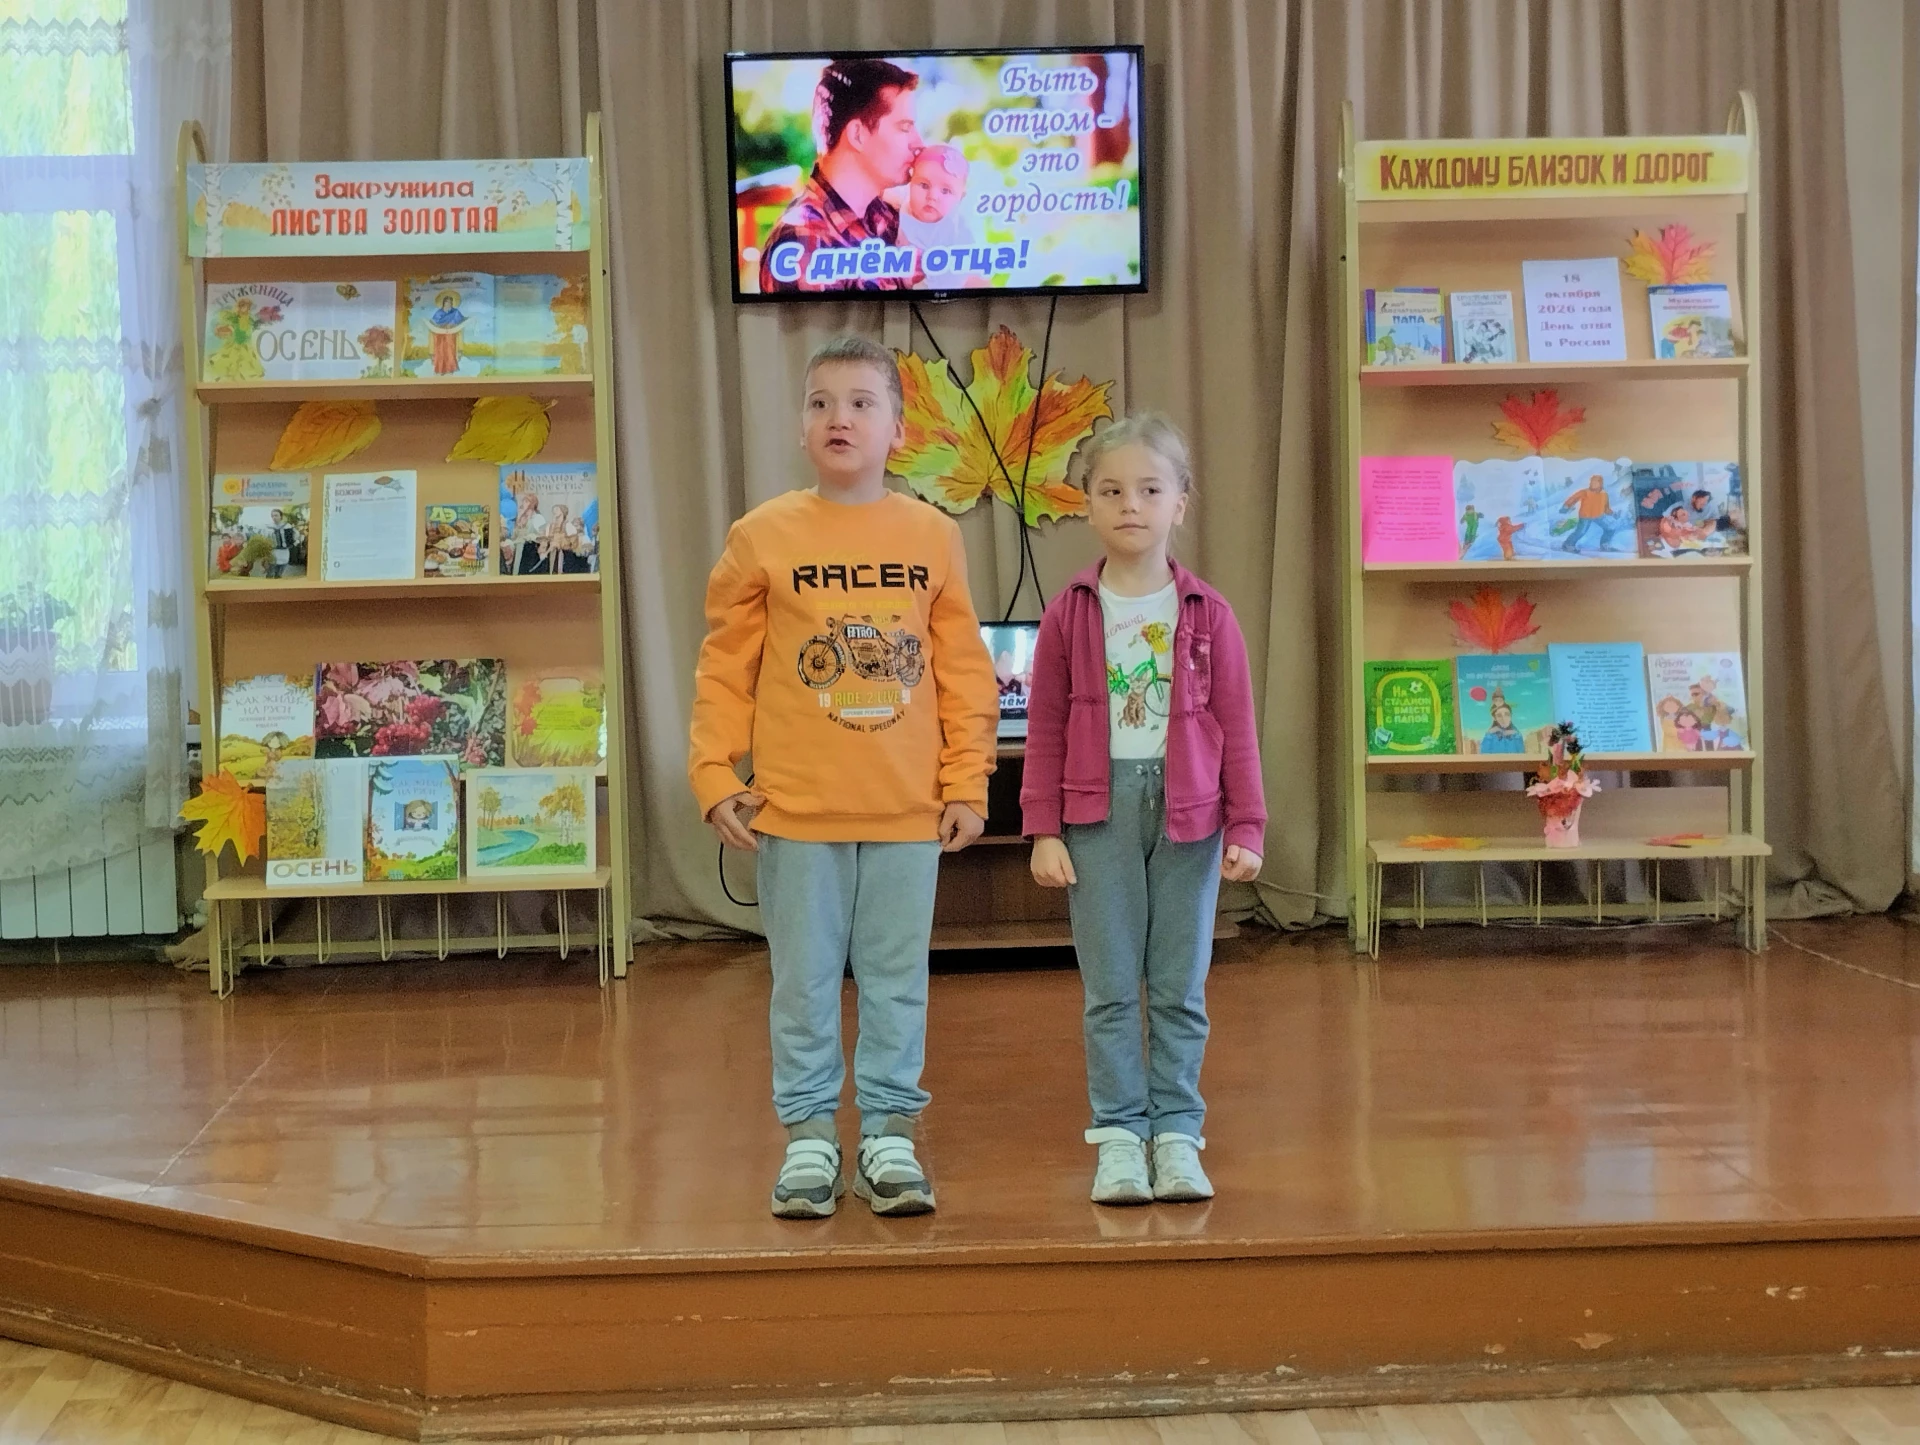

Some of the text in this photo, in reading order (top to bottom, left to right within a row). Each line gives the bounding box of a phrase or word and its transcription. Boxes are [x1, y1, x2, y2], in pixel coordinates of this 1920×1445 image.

[1003, 66, 1095, 94] Быть
[988, 112, 1091, 138] отцом
[1022, 150, 1080, 173] это
[1508, 154, 1607, 187] БЛИЗОК
[1613, 155, 1627, 184] И
[1633, 152, 1714, 184] ДОРОГ
[314, 173, 476, 200] Закружила
[977, 183, 1128, 223] гордость!
[270, 206, 498, 237] ЛИСТВА ЗОЛОТАЯ
[773, 239, 1029, 281] С днём отца!
[1537, 304, 1576, 314] 2026
[1540, 321, 1575, 331] День
[256, 328, 362, 363] ОСЕНЬ
[1558, 338, 1611, 347] России
[792, 563, 929, 595] RACER
[834, 690, 862, 706] RIDE
[868, 692, 876, 703] 2
[878, 689, 900, 704] LIVE
[826, 709, 907, 733] NATIONAL SPEEDWAY
[273, 859, 358, 878] ОСЕНЬ
